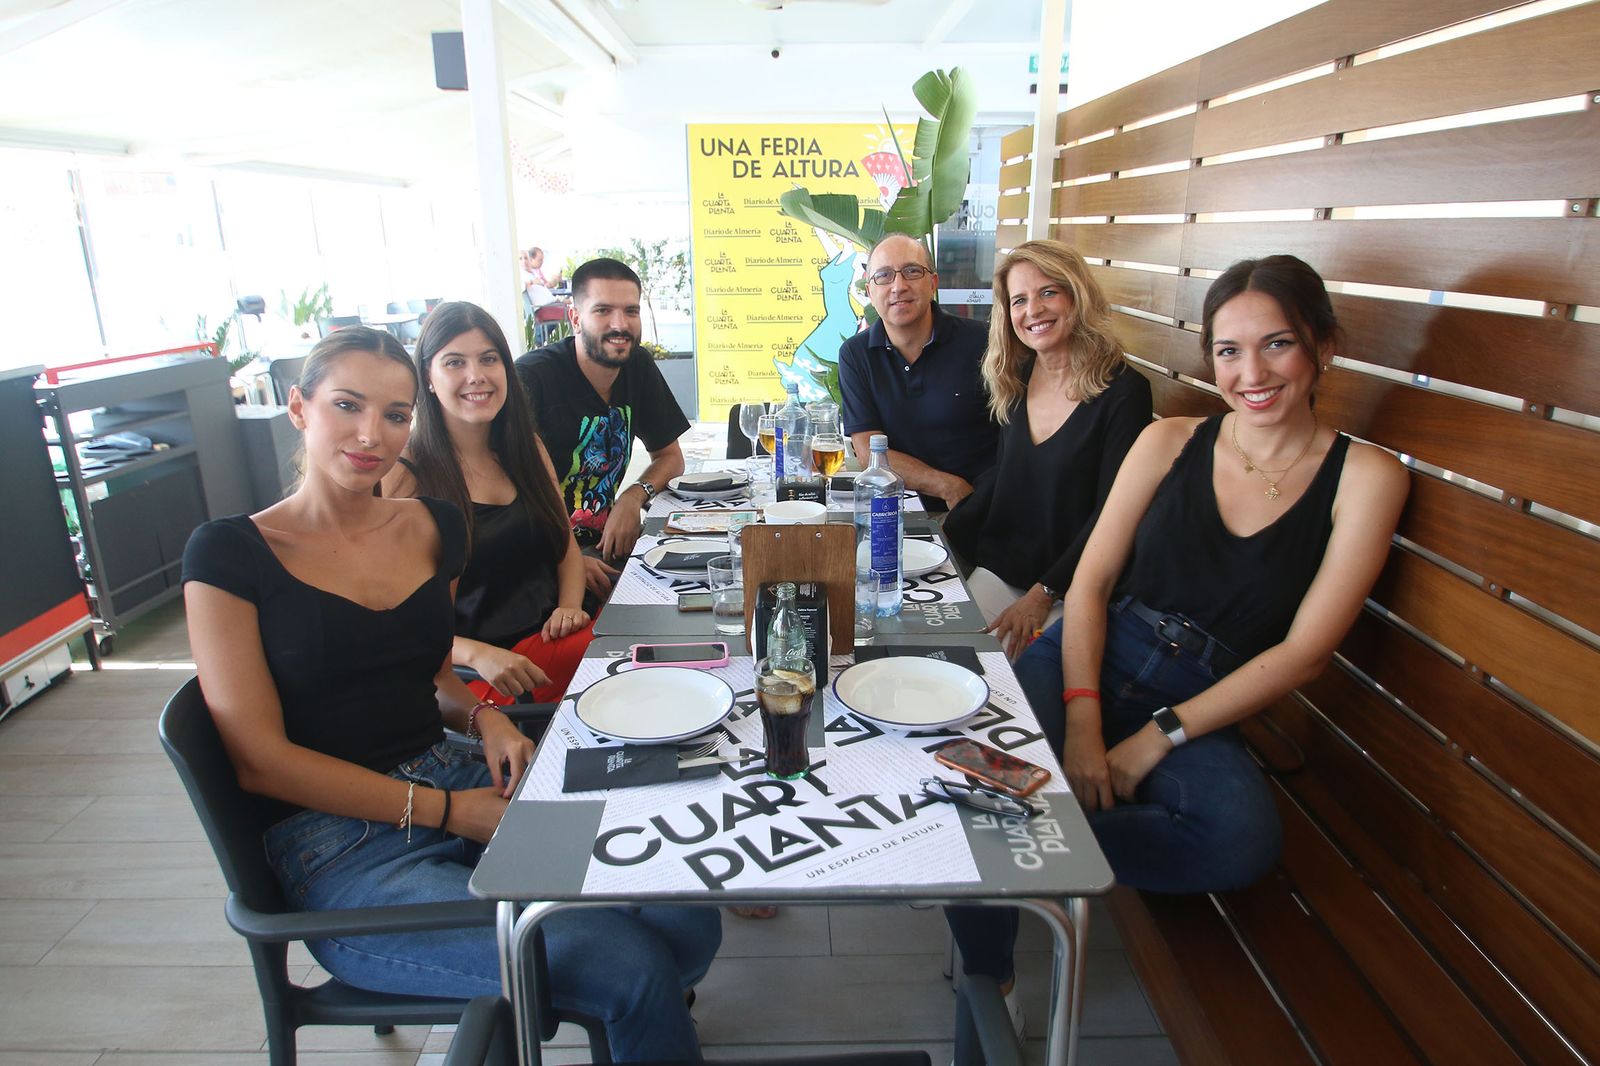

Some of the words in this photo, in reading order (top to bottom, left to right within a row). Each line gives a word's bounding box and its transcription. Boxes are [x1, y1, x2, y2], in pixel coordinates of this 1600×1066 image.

[700, 137, 752, 156] UNA
[760, 137, 823, 156] FERIA
[732, 160, 762, 179] DE
[772, 159, 860, 178] ALTURA
[920, 602, 945, 626] CUAR
[942, 602, 963, 620] PLAN
[806, 867, 826, 879] UN
[828, 847, 880, 871] ESPACIO
[882, 839, 900, 848] DE
[901, 822, 944, 843] ALTURA
